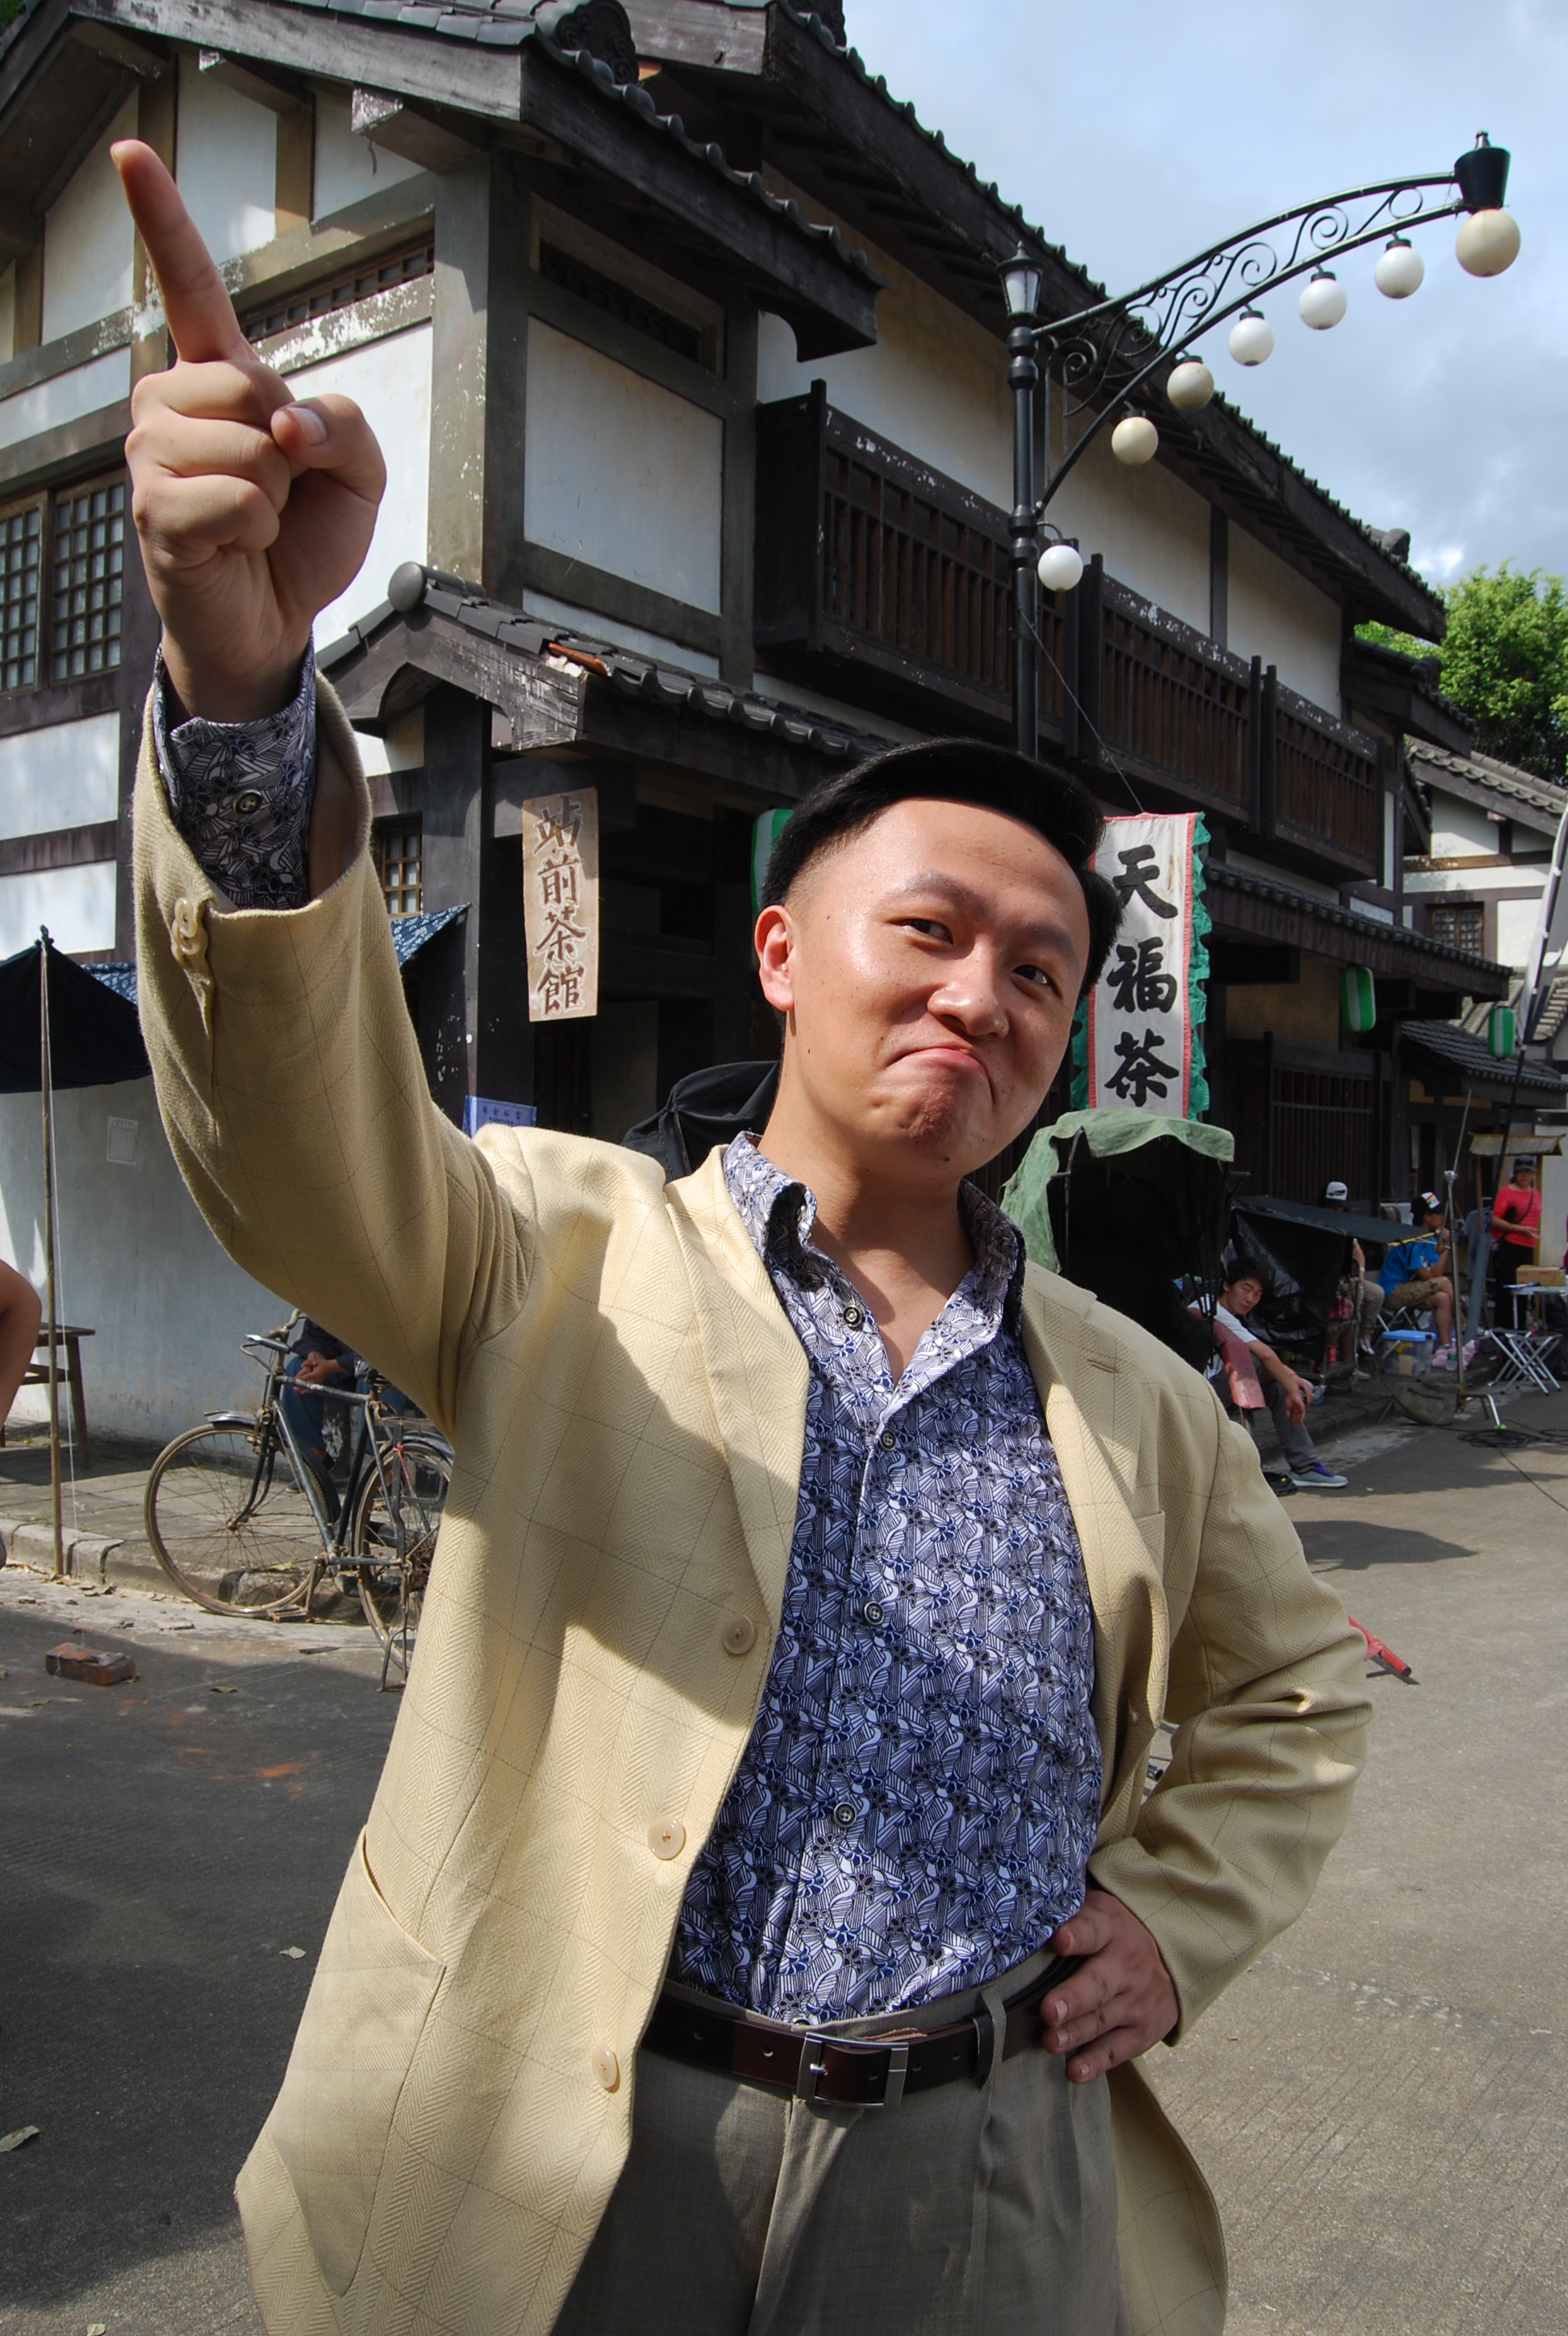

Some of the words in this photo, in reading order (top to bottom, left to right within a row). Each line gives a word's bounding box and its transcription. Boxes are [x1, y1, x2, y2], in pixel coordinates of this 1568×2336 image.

[533, 795, 586, 1015] 站前茶館
[1104, 844, 1179, 1108] 天福茶
